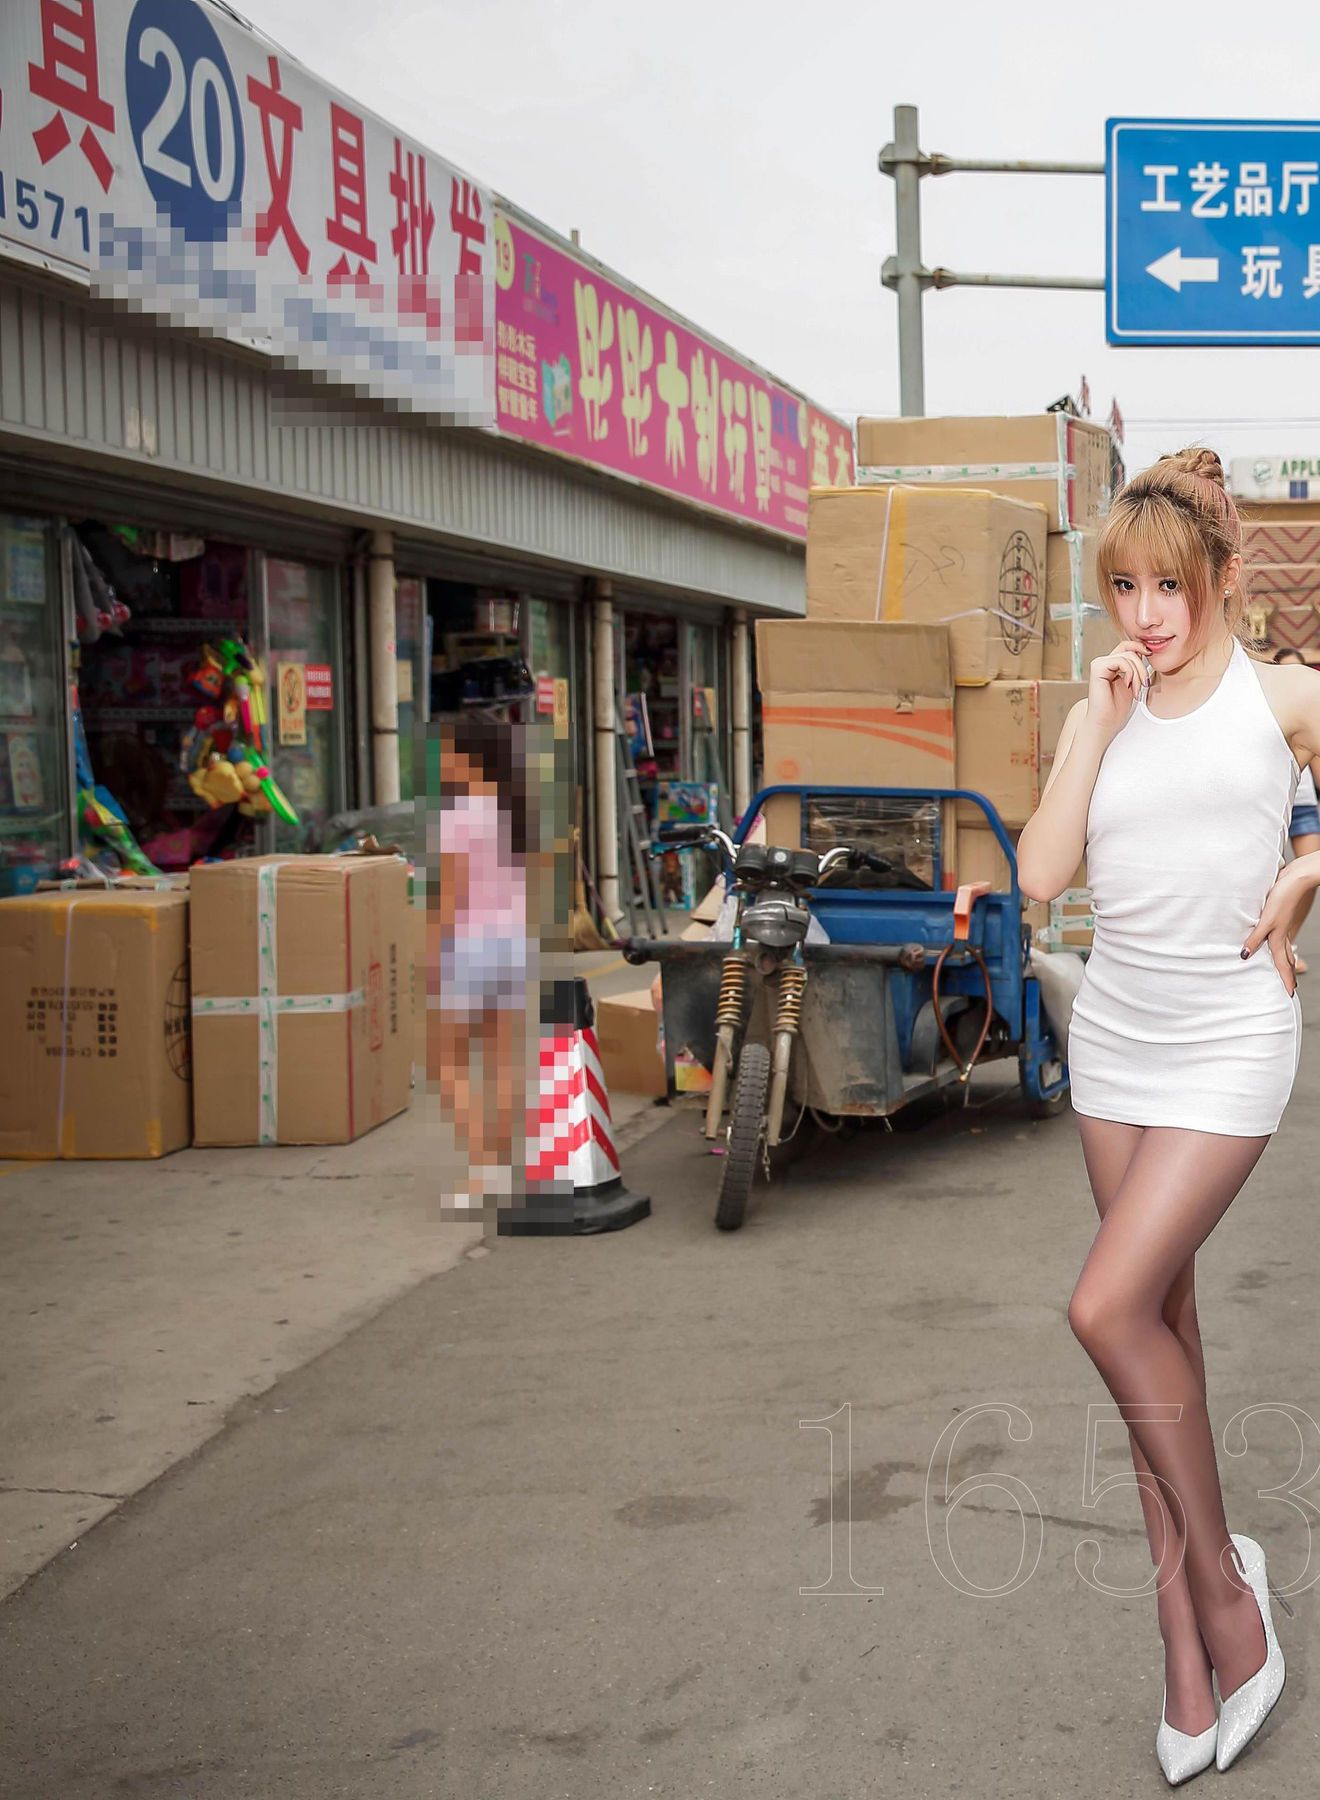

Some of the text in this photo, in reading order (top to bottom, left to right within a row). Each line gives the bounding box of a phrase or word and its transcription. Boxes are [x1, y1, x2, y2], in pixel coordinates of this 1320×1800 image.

[138, 26, 236, 202] 20
[1140, 161, 1319, 218] 工艺品厅
